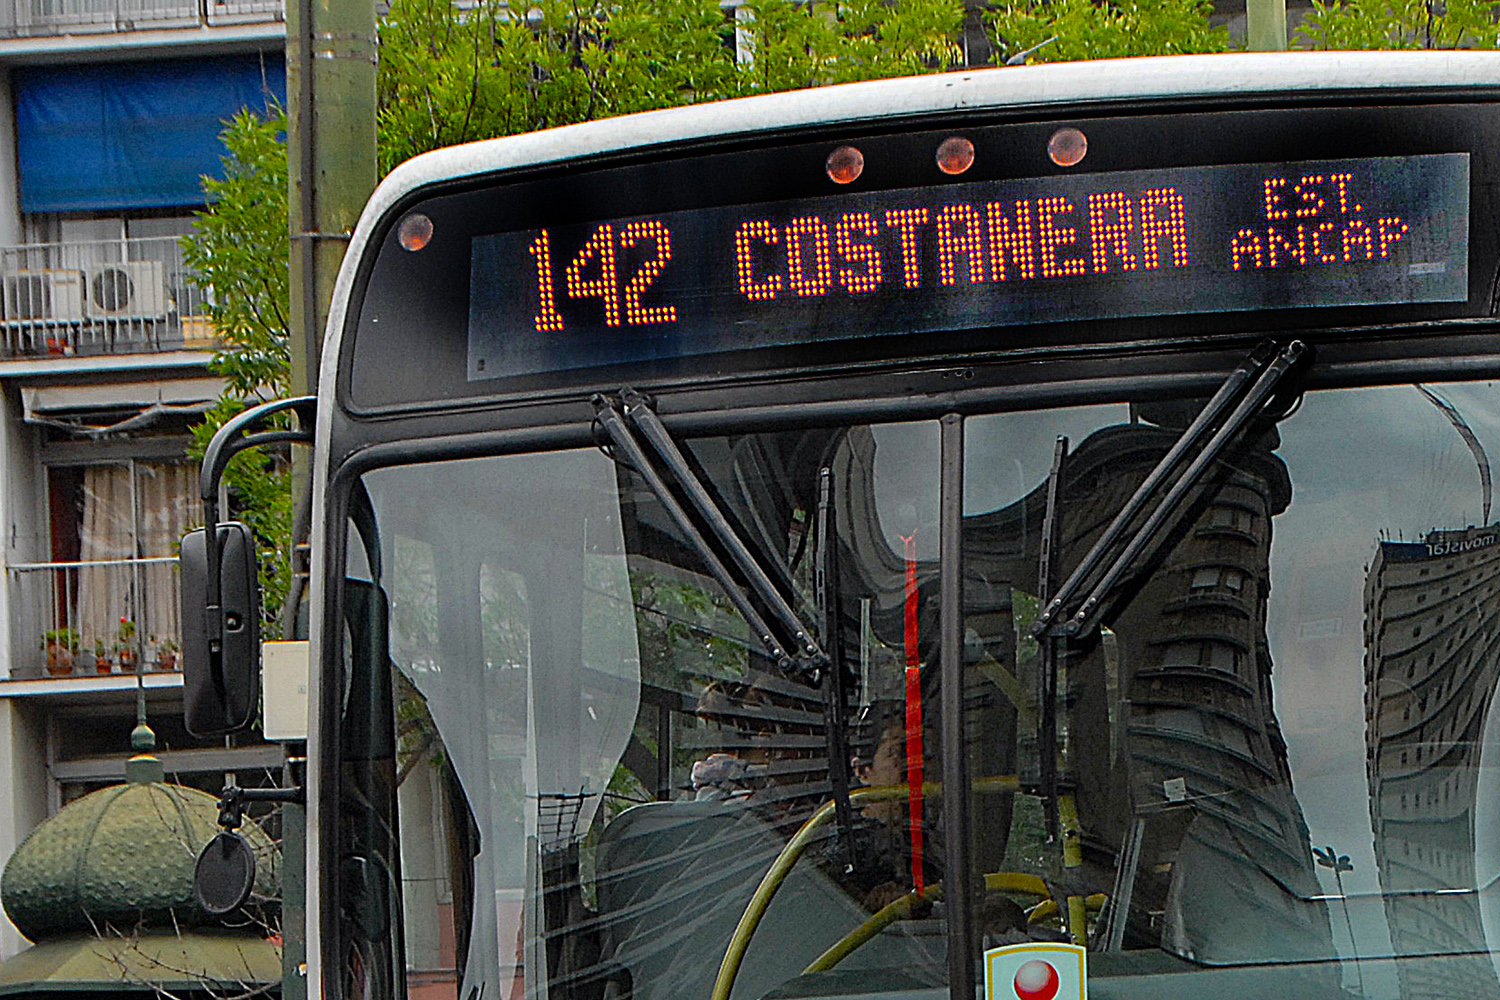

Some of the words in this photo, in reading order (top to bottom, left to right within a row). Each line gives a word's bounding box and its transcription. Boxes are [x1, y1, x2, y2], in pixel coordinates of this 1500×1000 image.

[528, 219, 677, 332] 142
[734, 186, 1188, 301] COSTANERA
[1232, 216, 1408, 271] ANCAP
